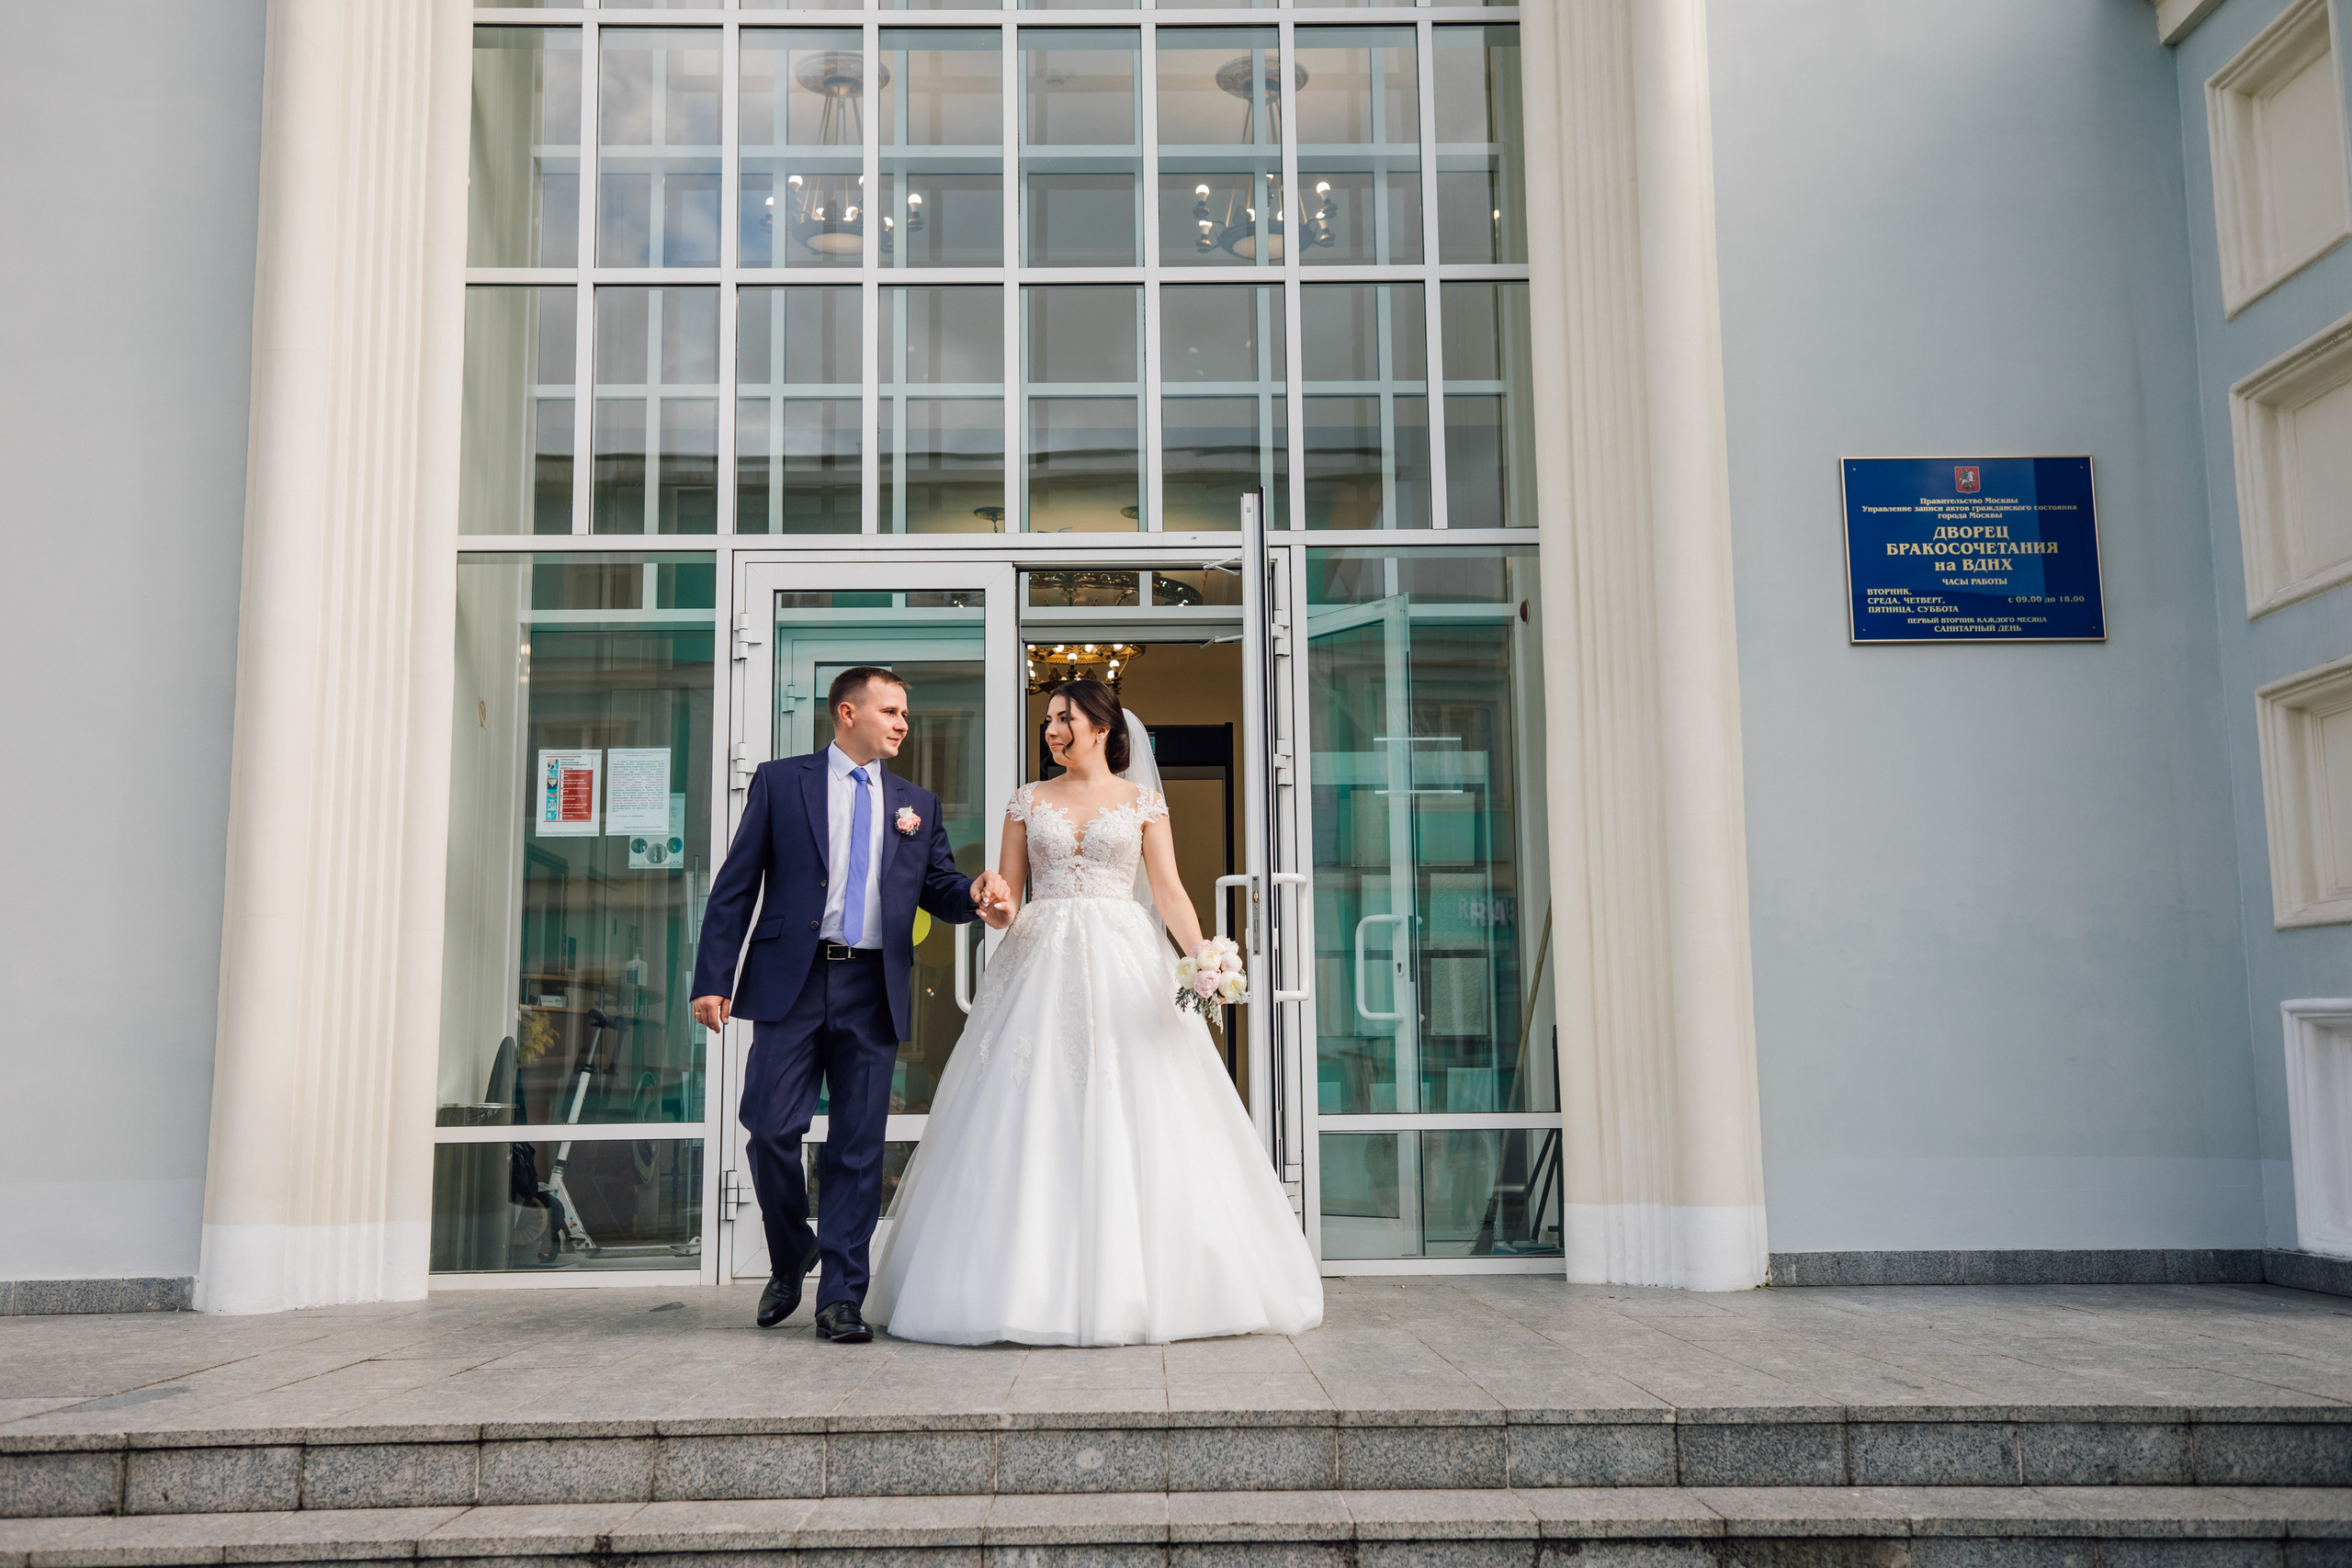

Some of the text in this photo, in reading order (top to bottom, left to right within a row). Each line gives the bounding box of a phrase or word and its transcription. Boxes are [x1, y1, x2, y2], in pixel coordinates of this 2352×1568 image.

[1920, 497, 1983, 506] Правительство
[1933, 526, 2010, 541] ДВОРЕЦ
[1886, 541, 2058, 556] БРАКОСОЧЕТАНИЯ
[1934, 558, 2013, 573] на ВДНХ
